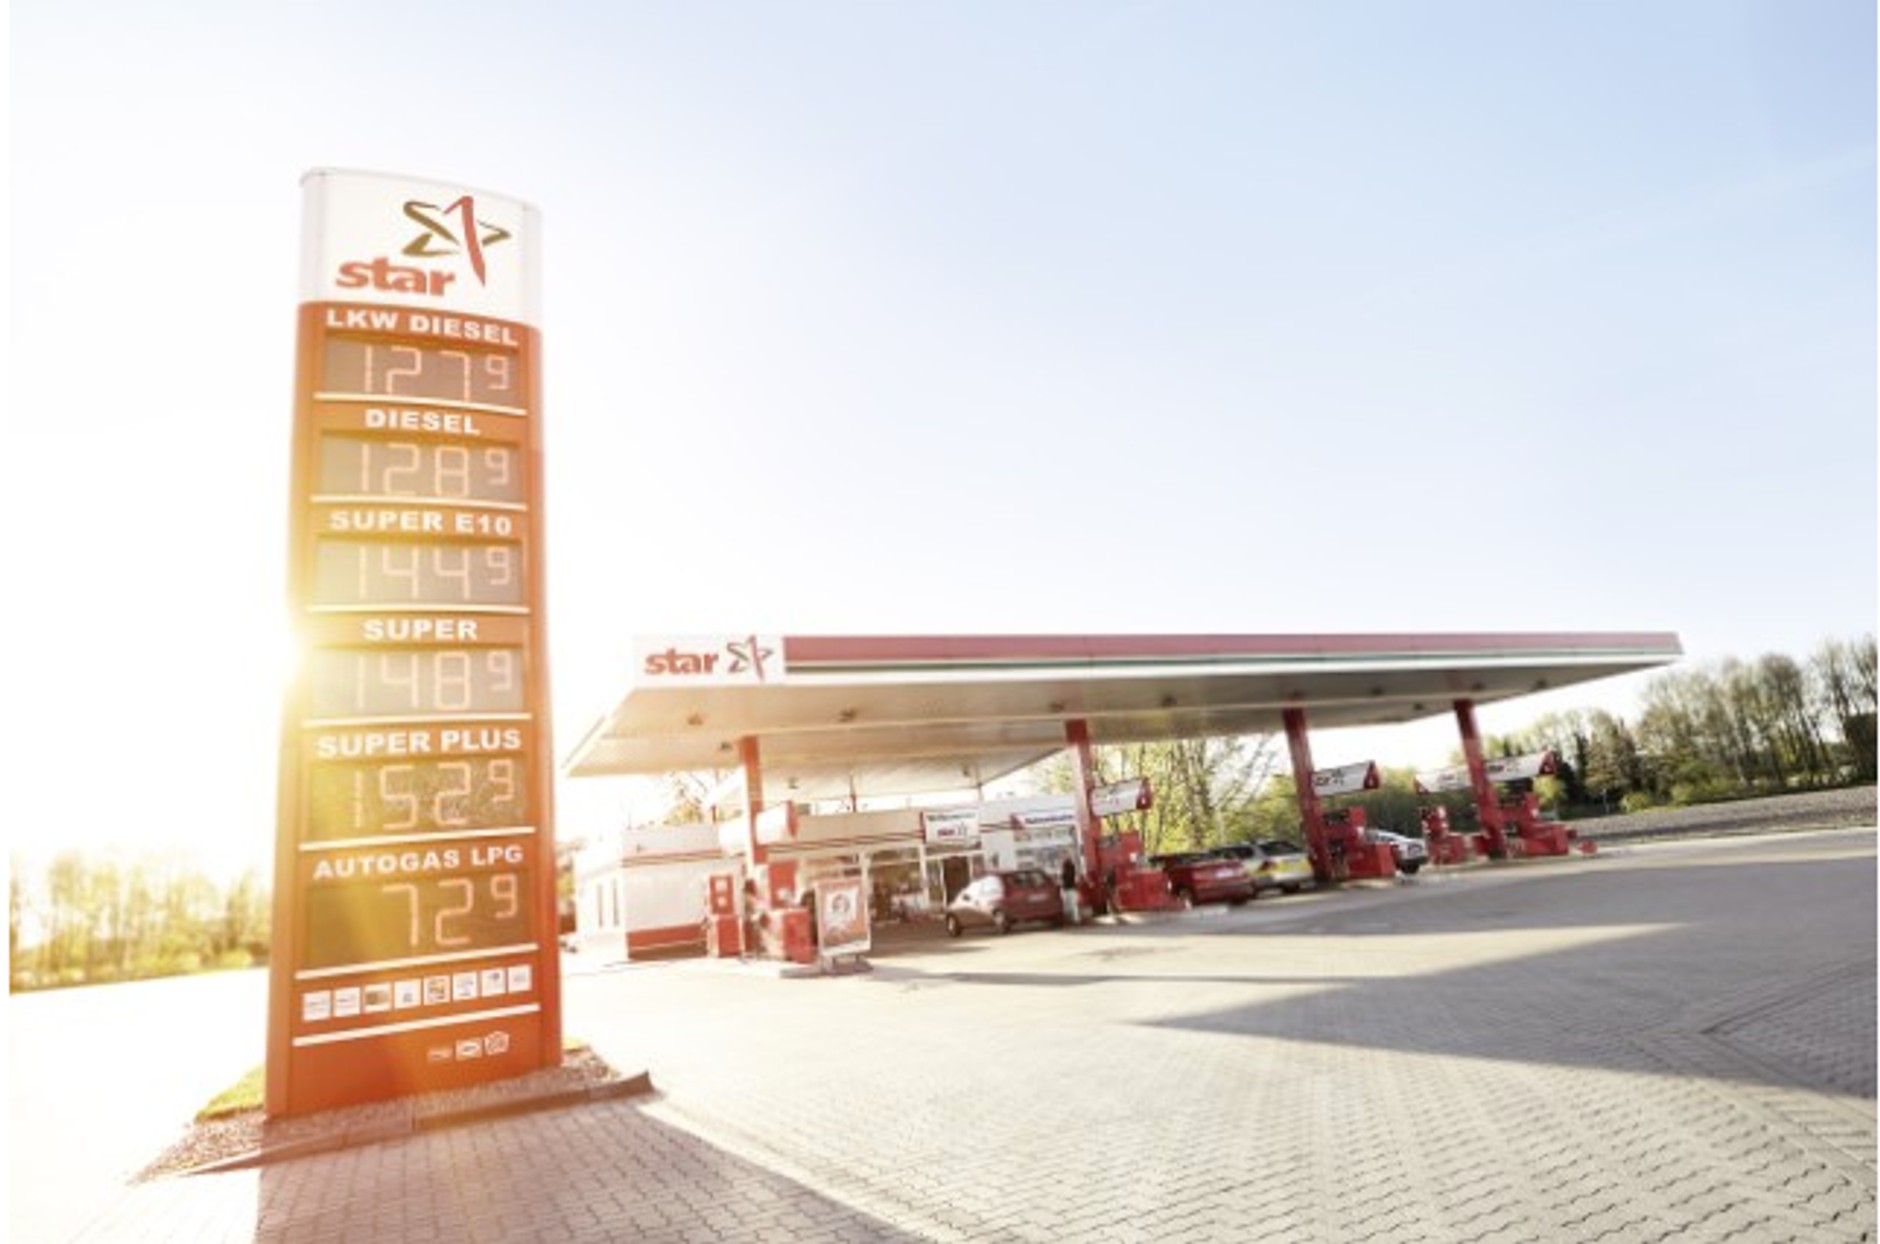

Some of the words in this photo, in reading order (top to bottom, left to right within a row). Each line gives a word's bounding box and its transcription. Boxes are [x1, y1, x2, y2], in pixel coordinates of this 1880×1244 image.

[336, 257, 455, 296] star
[327, 309, 398, 329] LKW
[410, 315, 518, 345] DIESEL
[365, 408, 481, 436] DIESEL
[330, 510, 443, 531] SUPER
[455, 513, 512, 535] E10
[364, 619, 478, 641] SUPER
[645, 648, 719, 675] star
[317, 731, 431, 758] SUPER
[441, 729, 521, 752] PLUS
[313, 850, 460, 879] AUTOGAS
[471, 845, 523, 866] LPG
